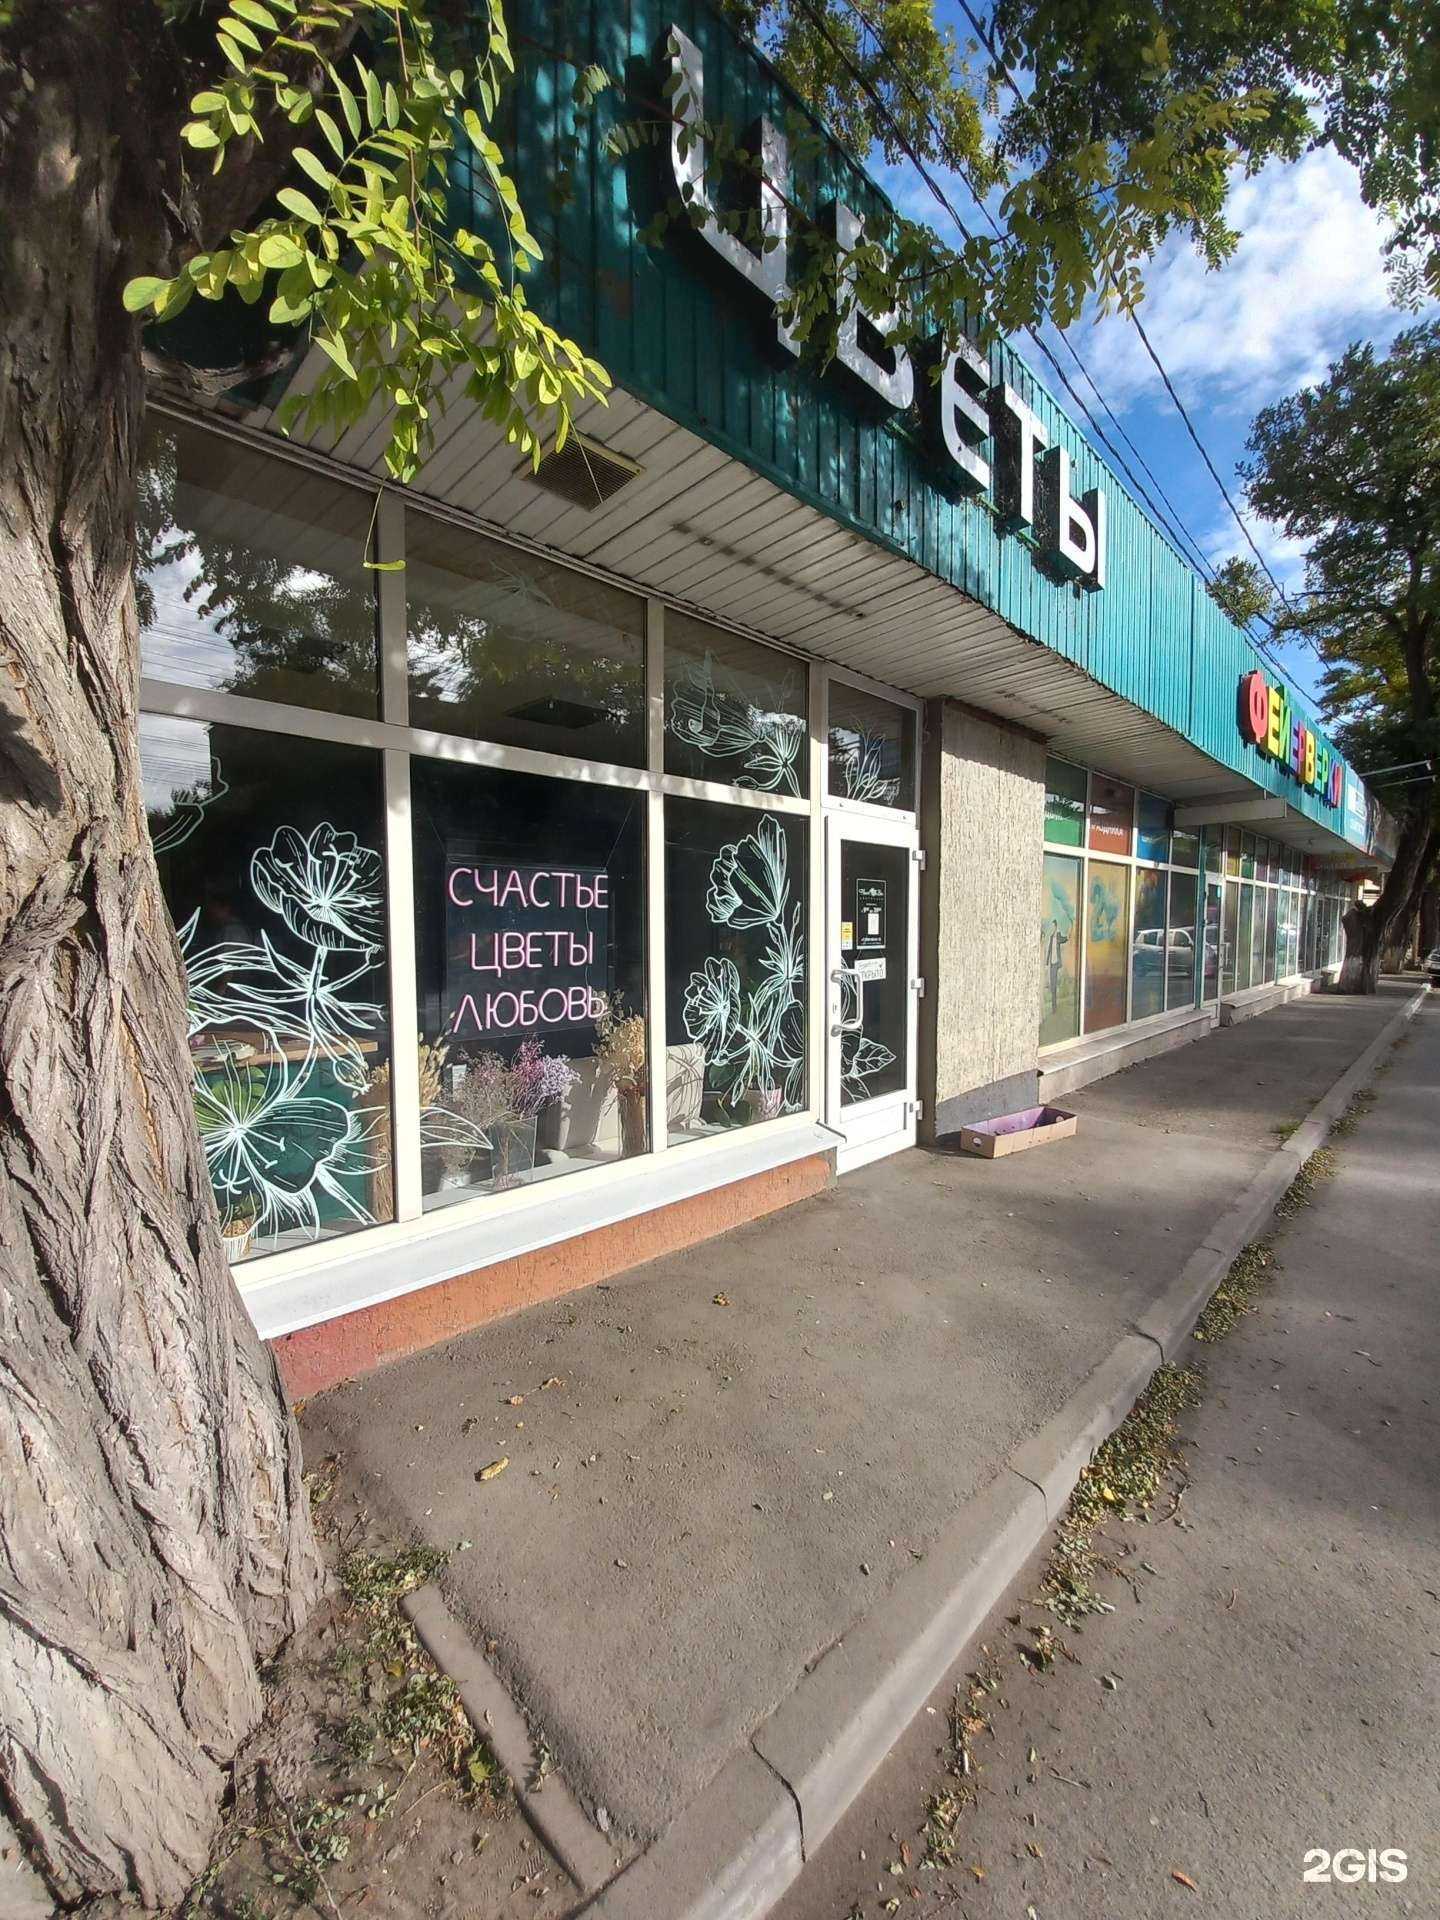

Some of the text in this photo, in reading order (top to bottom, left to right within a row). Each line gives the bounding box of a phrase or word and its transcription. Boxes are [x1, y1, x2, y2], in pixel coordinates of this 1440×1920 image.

[449, 867, 609, 909] СЧАСТЬЕ
[471, 932, 593, 978] ЦВЕТЫ
[452, 985, 605, 1034] ЛЮБОВЬ
